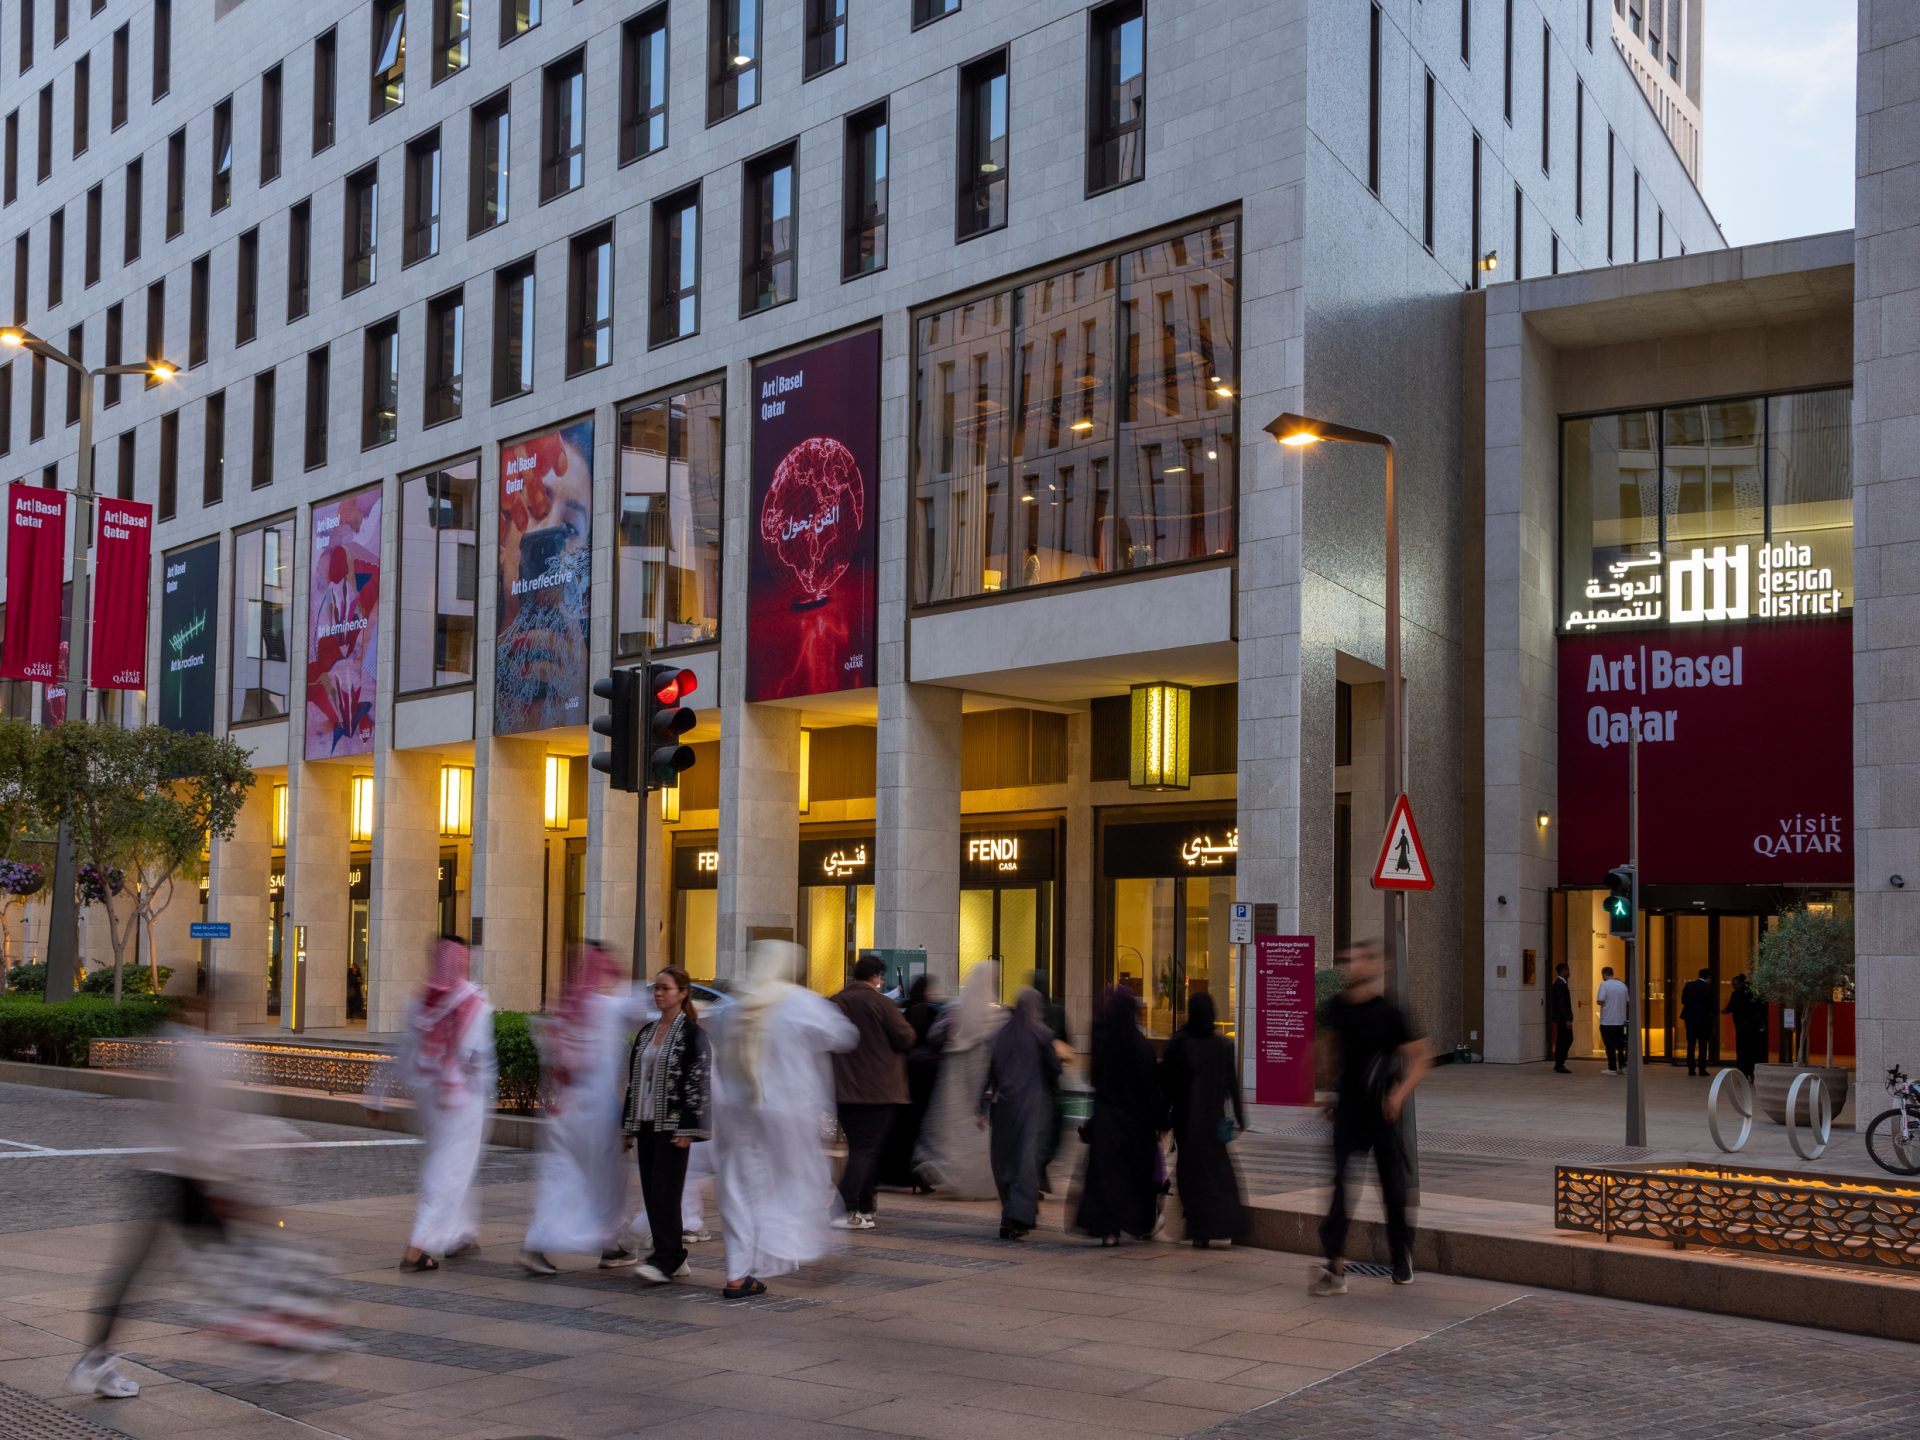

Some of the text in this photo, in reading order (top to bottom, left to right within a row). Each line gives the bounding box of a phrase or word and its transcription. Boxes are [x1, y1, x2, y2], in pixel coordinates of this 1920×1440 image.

[761, 401, 785, 421] Qatar
[505, 478, 524, 496] Qatar
[15, 513, 43, 528] Qatar
[814, 505, 840, 534] الفن
[103, 525, 130, 540] Qatar
[1758, 541, 1812, 570] doha
[528, 570, 573, 591] reflective
[1585, 575, 1662, 601] الدوحة
[1758, 568, 1832, 594] design
[1758, 589, 1843, 617] district
[330, 617, 368, 635] eminence
[1565, 600, 1662, 630] للتصميم
[24, 667, 52, 677] QATAR
[112, 675, 140, 684] QATAR
[1587, 705, 1678, 748] Qatar
[1779, 813, 1842, 833] visit
[969, 838, 1018, 861] FENDI
[1753, 833, 1842, 858] QATAR
[823, 844, 866, 876] فندي
[999, 862, 1017, 871] CASA
